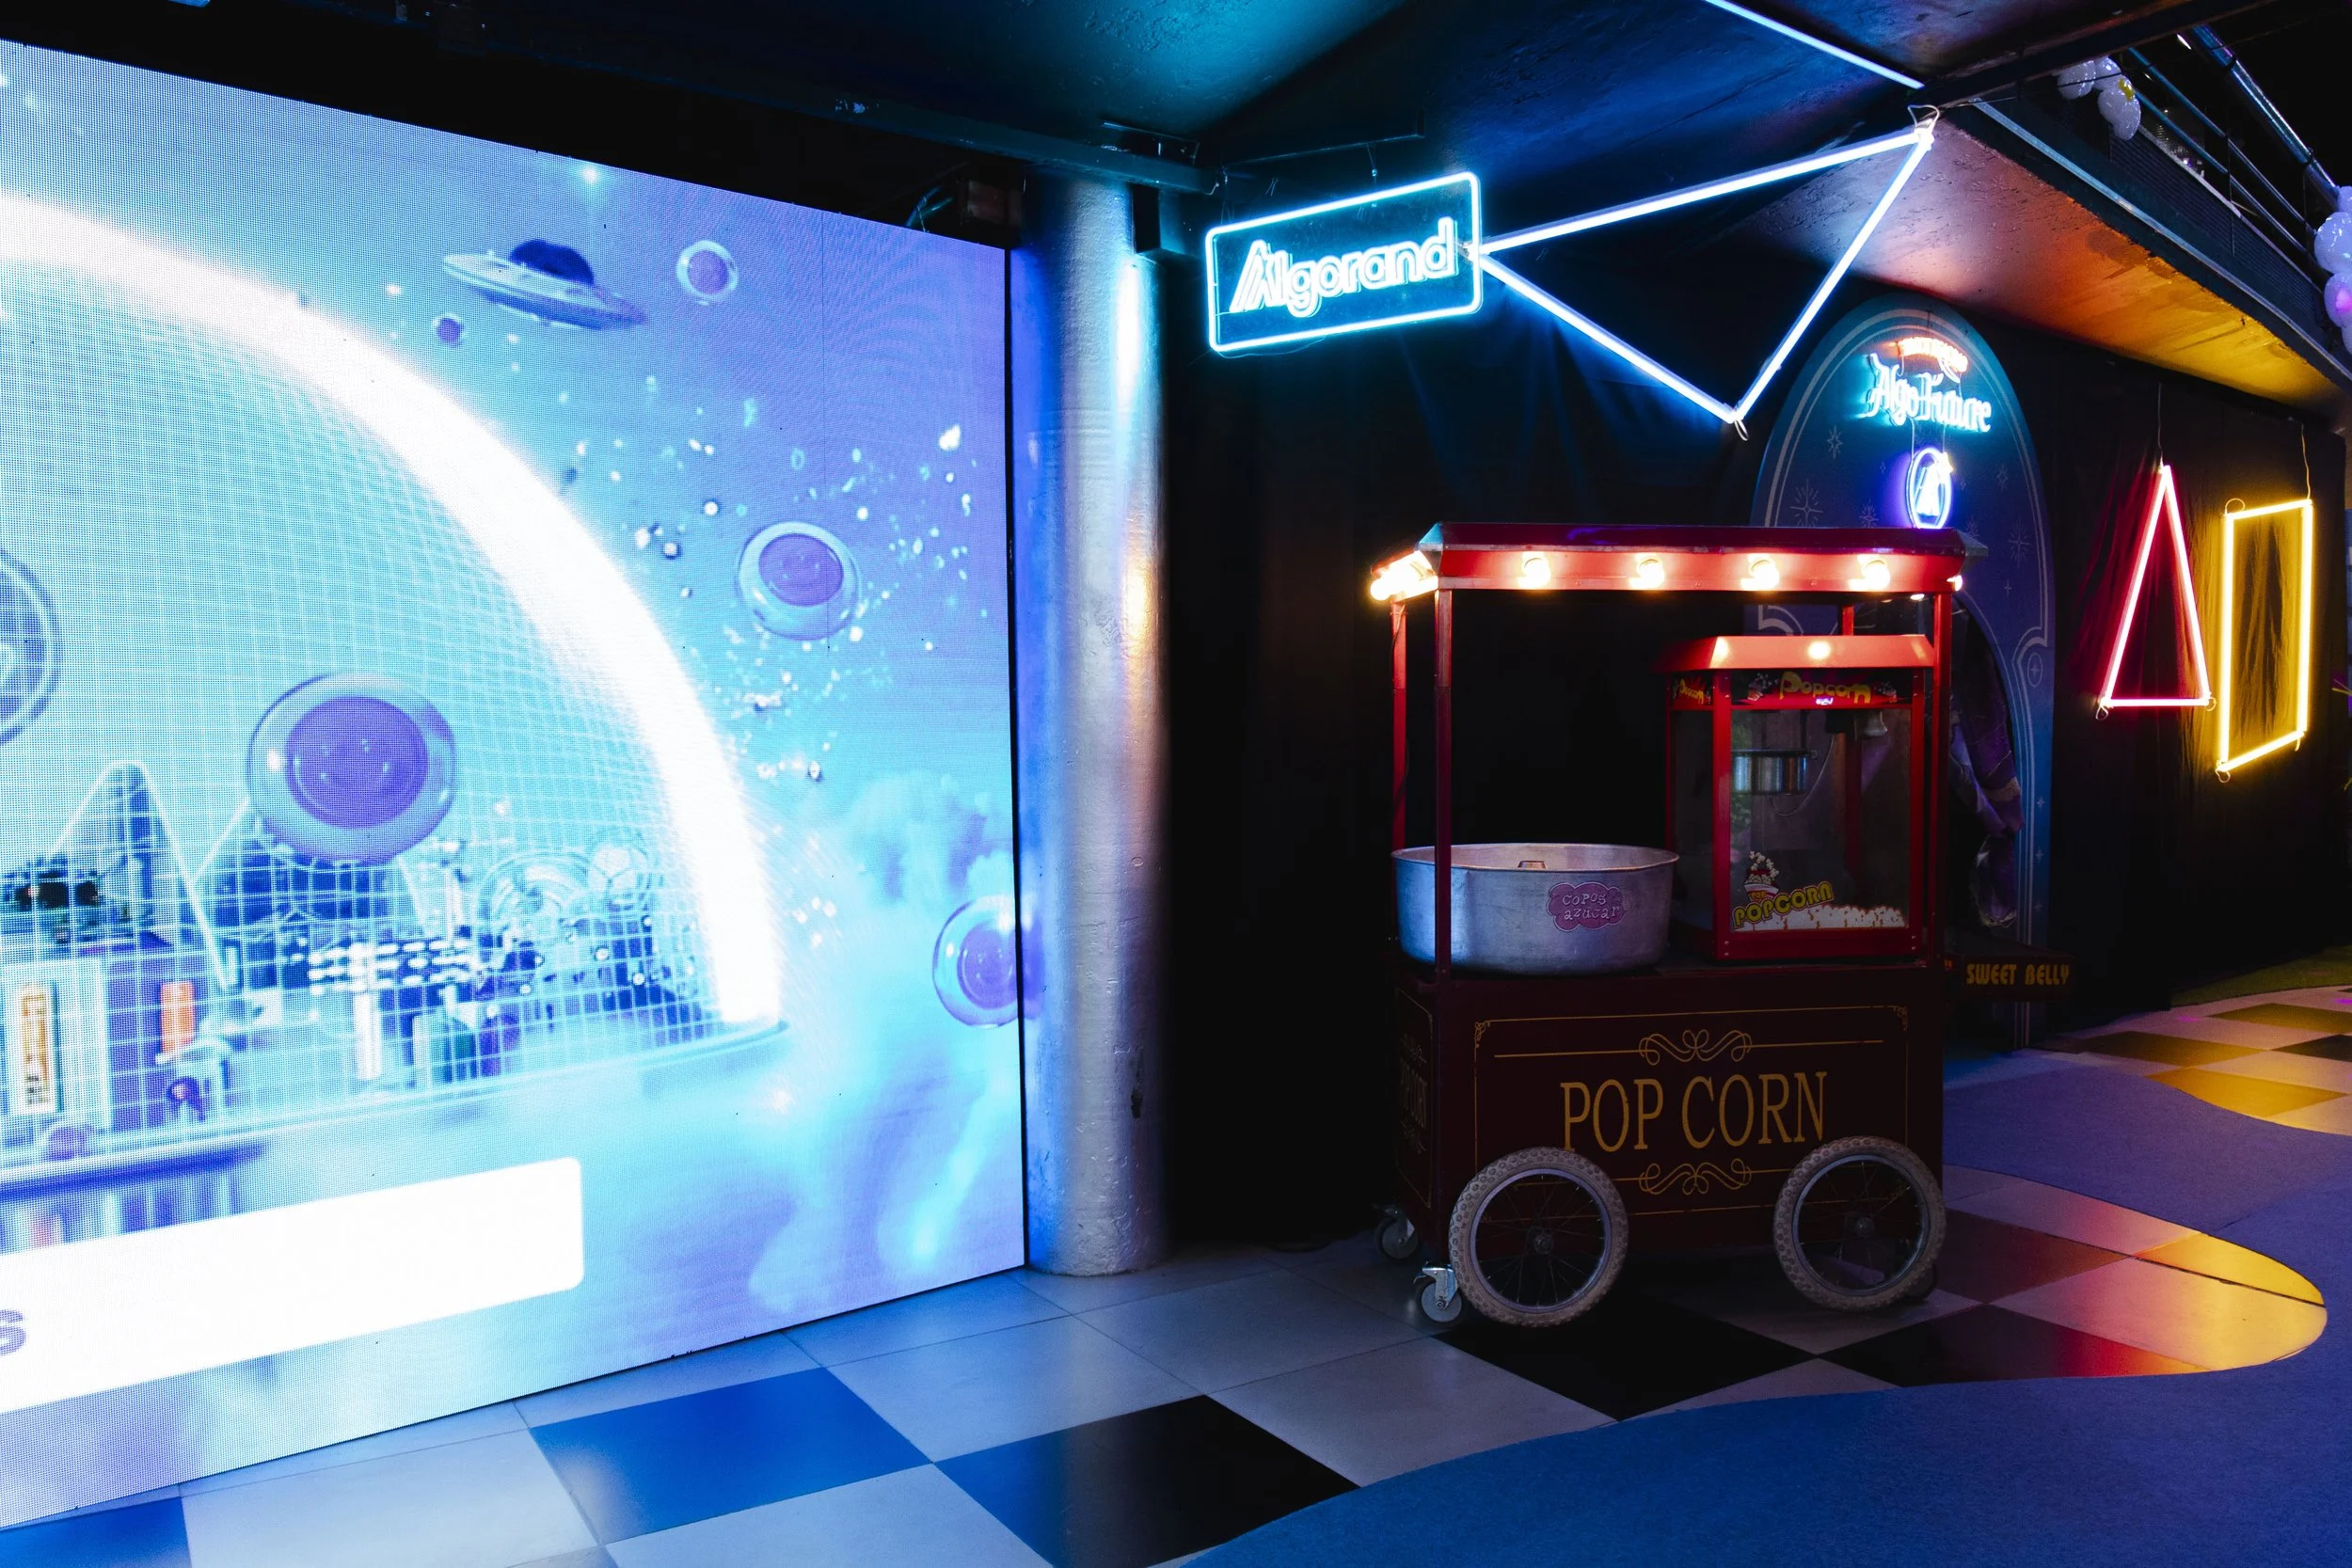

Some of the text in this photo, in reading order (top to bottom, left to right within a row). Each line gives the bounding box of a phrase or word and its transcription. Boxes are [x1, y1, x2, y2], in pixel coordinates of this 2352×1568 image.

[1229, 215, 1456, 318] Algorand
[1779, 671, 1871, 705] Popcorn
[1733, 880, 1834, 928] POPCORN
[1965, 963, 2070, 986] SWEET BELLY
[1560, 1070, 1828, 1153] POP CORN
